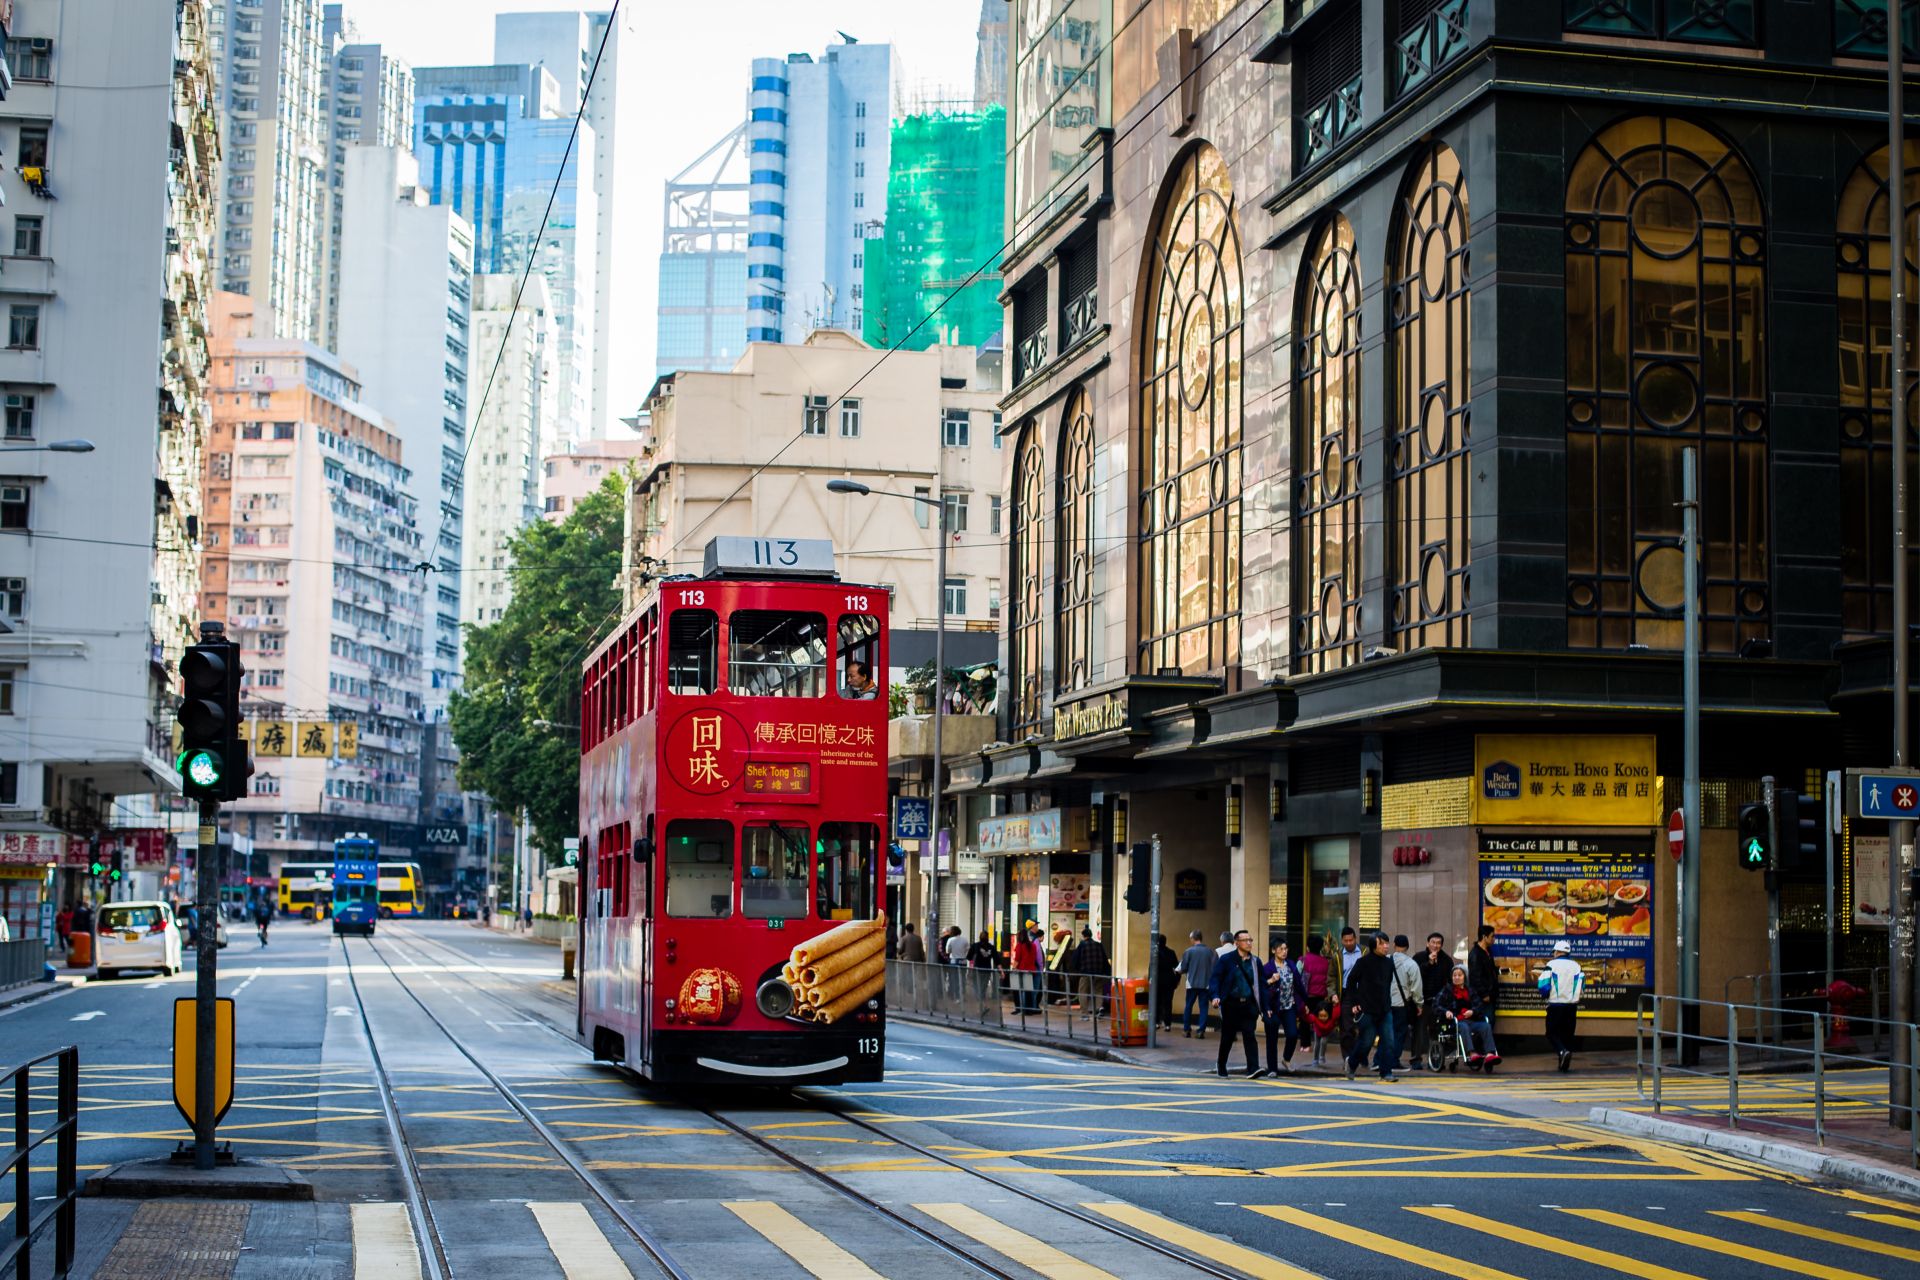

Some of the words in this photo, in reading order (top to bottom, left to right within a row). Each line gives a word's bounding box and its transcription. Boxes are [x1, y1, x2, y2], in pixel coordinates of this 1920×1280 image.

[754, 540, 799, 566] 113
[679, 590, 705, 606] 113
[845, 596, 868, 611] 113
[753, 721, 875, 747] 傳承回憶之味
[820, 750, 856, 758] Inheritance
[864, 751, 874, 759] the
[747, 765, 767, 777] Shek
[770, 766, 789, 779] Tong
[793, 767, 808, 778] Tsui
[1493, 772, 1510, 782] Best
[753, 779, 802, 790] 石塘咀
[1486, 780, 1517, 789] Western
[1529, 781, 1649, 797] 華大盛品酒店
[899, 802, 928, 836] 藥
[426, 828, 459, 843] KAZA
[3, 833, 40, 854] 地產
[1487, 840, 1508, 850] The
[1510, 840, 1536, 850] Café
[338, 863, 375, 871] PIMCO
[768, 919, 784, 928] 031
[858, 1038, 879, 1054] 113
